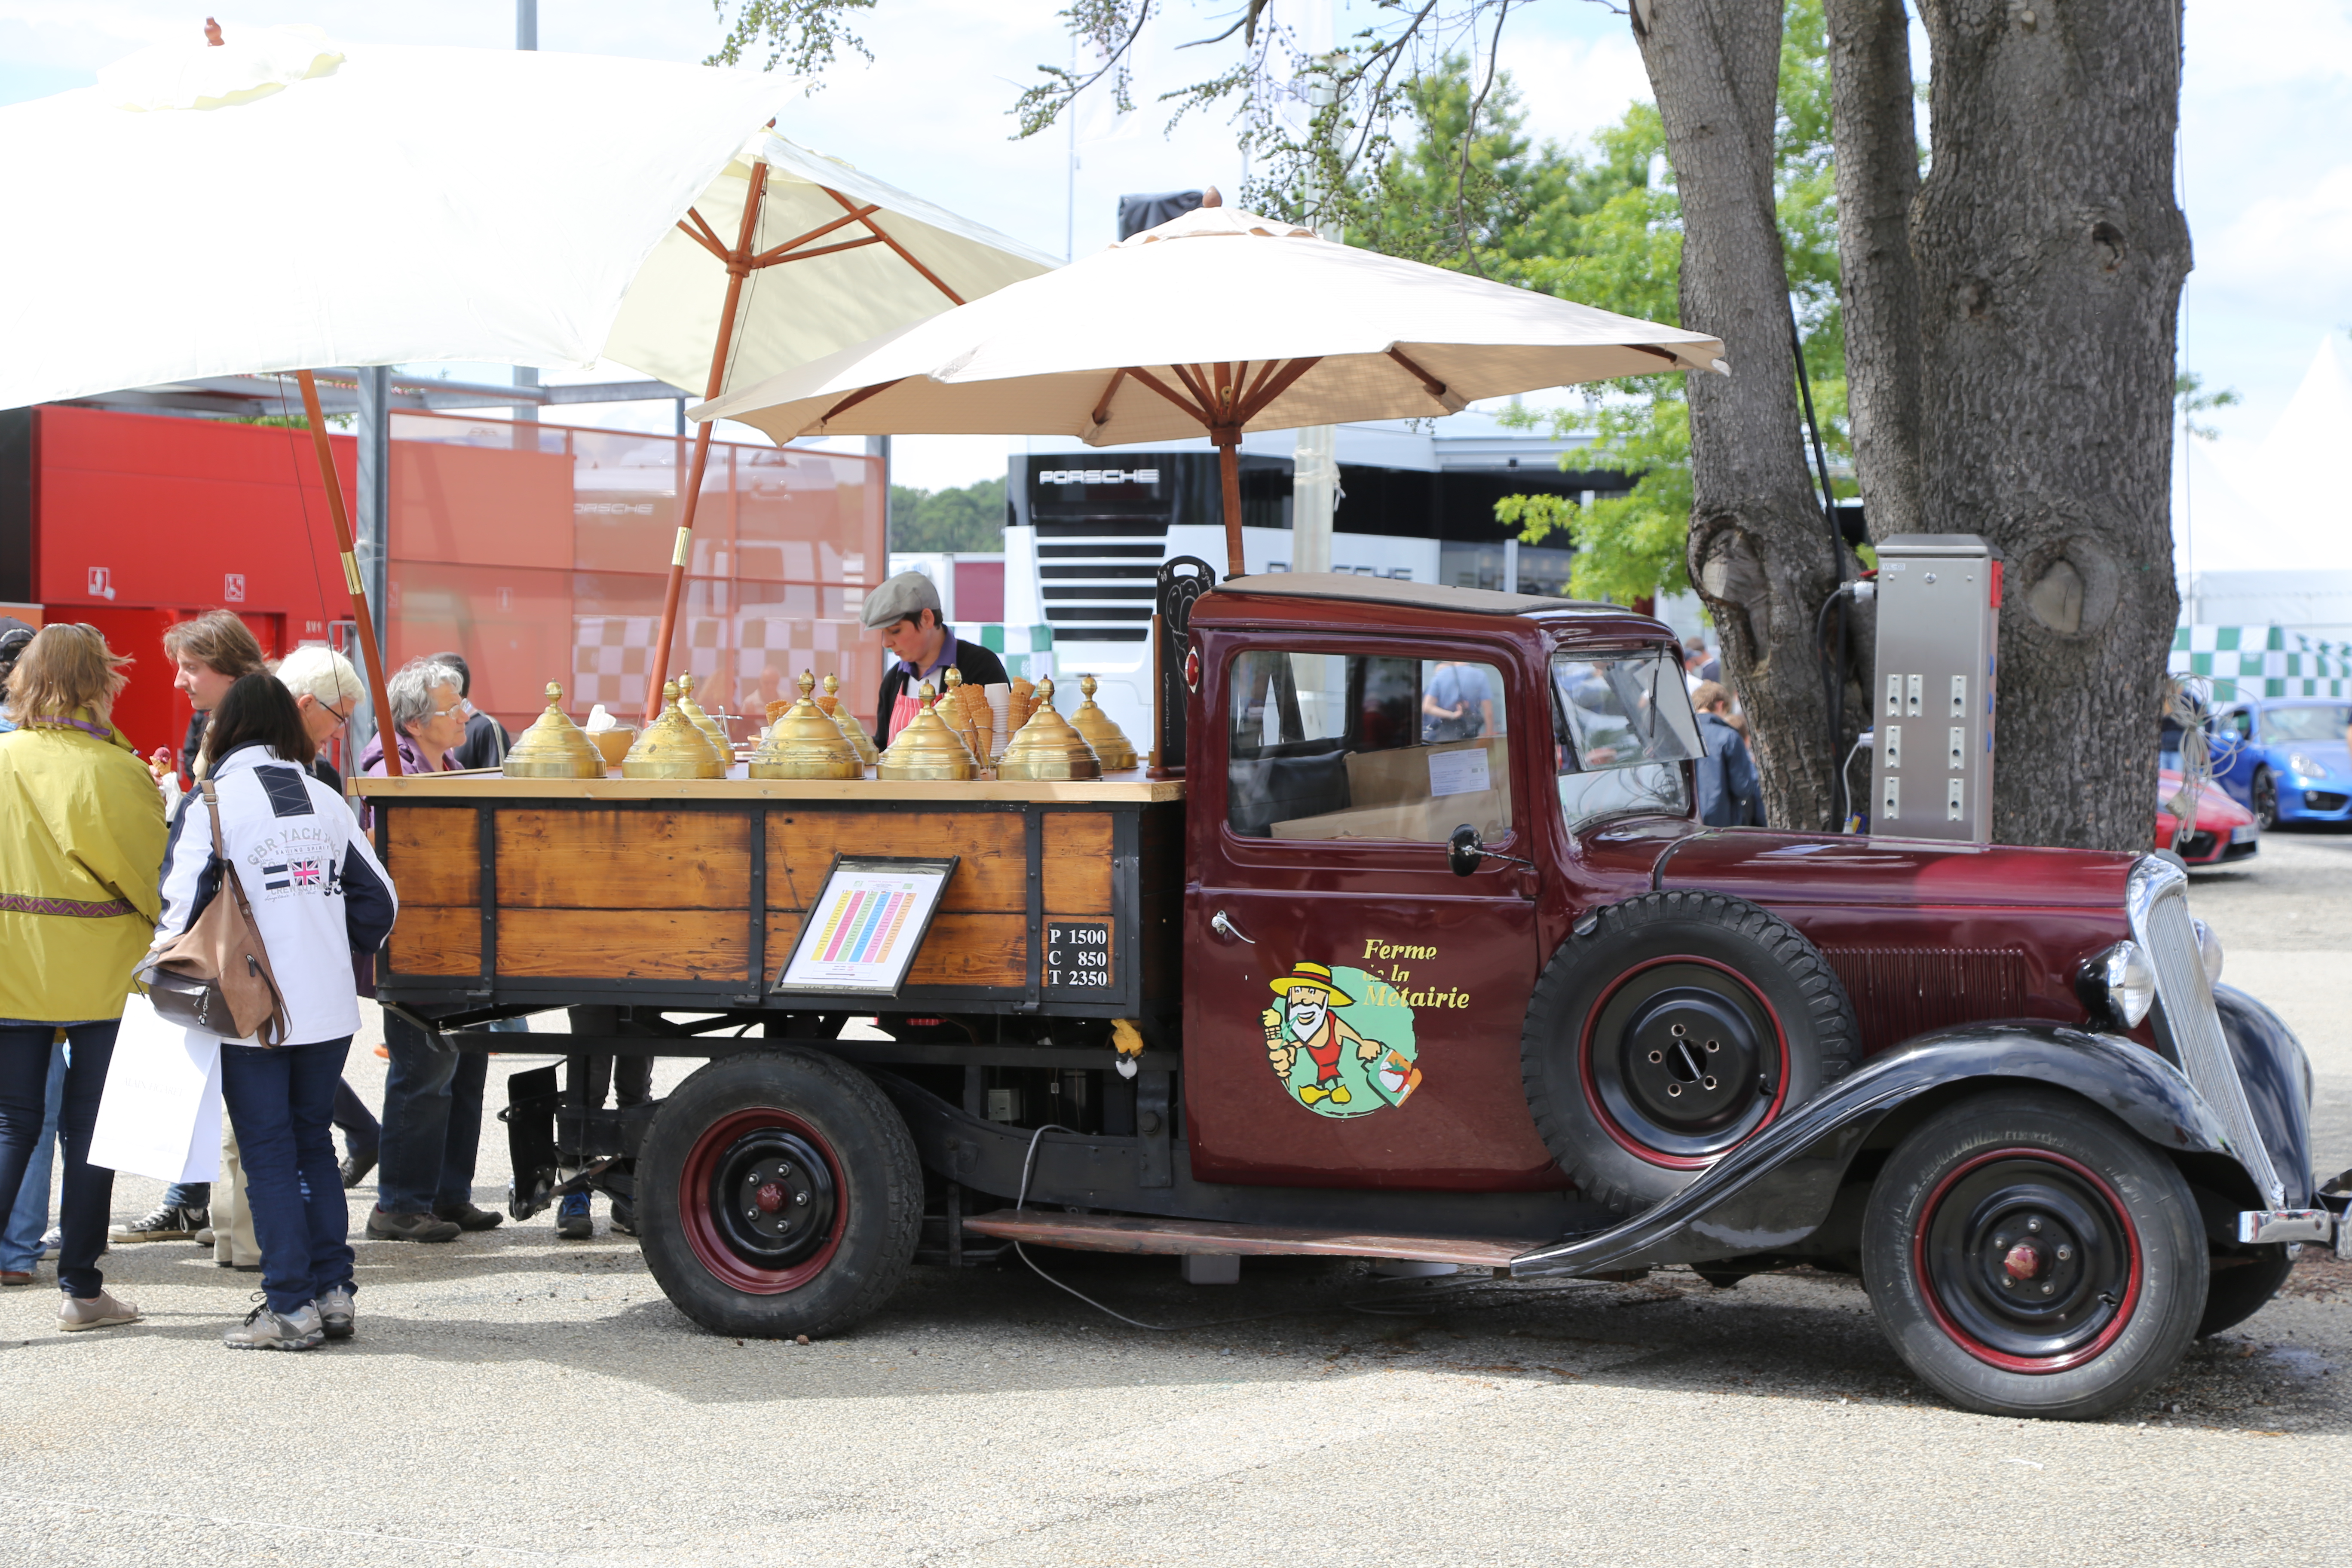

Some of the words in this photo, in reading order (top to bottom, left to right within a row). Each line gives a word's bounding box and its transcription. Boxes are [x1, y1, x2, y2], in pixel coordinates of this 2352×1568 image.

[1039, 469, 1160, 485] PORSCHE
[573, 503, 654, 515] ORSCHE
[247, 837, 277, 866] GBR
[270, 884, 297, 895] CREW
[1049, 929, 1061, 944] P
[1069, 929, 1107, 945] 1500
[1362, 939, 1437, 960] Ferme
[1048, 950, 1061, 965] C
[1078, 951, 1107, 967] 850
[1049, 970, 1061, 985] T
[1069, 970, 1108, 986] 2350
[1391, 964, 1410, 982] la
[1362, 985, 1470, 1009] Métairie
